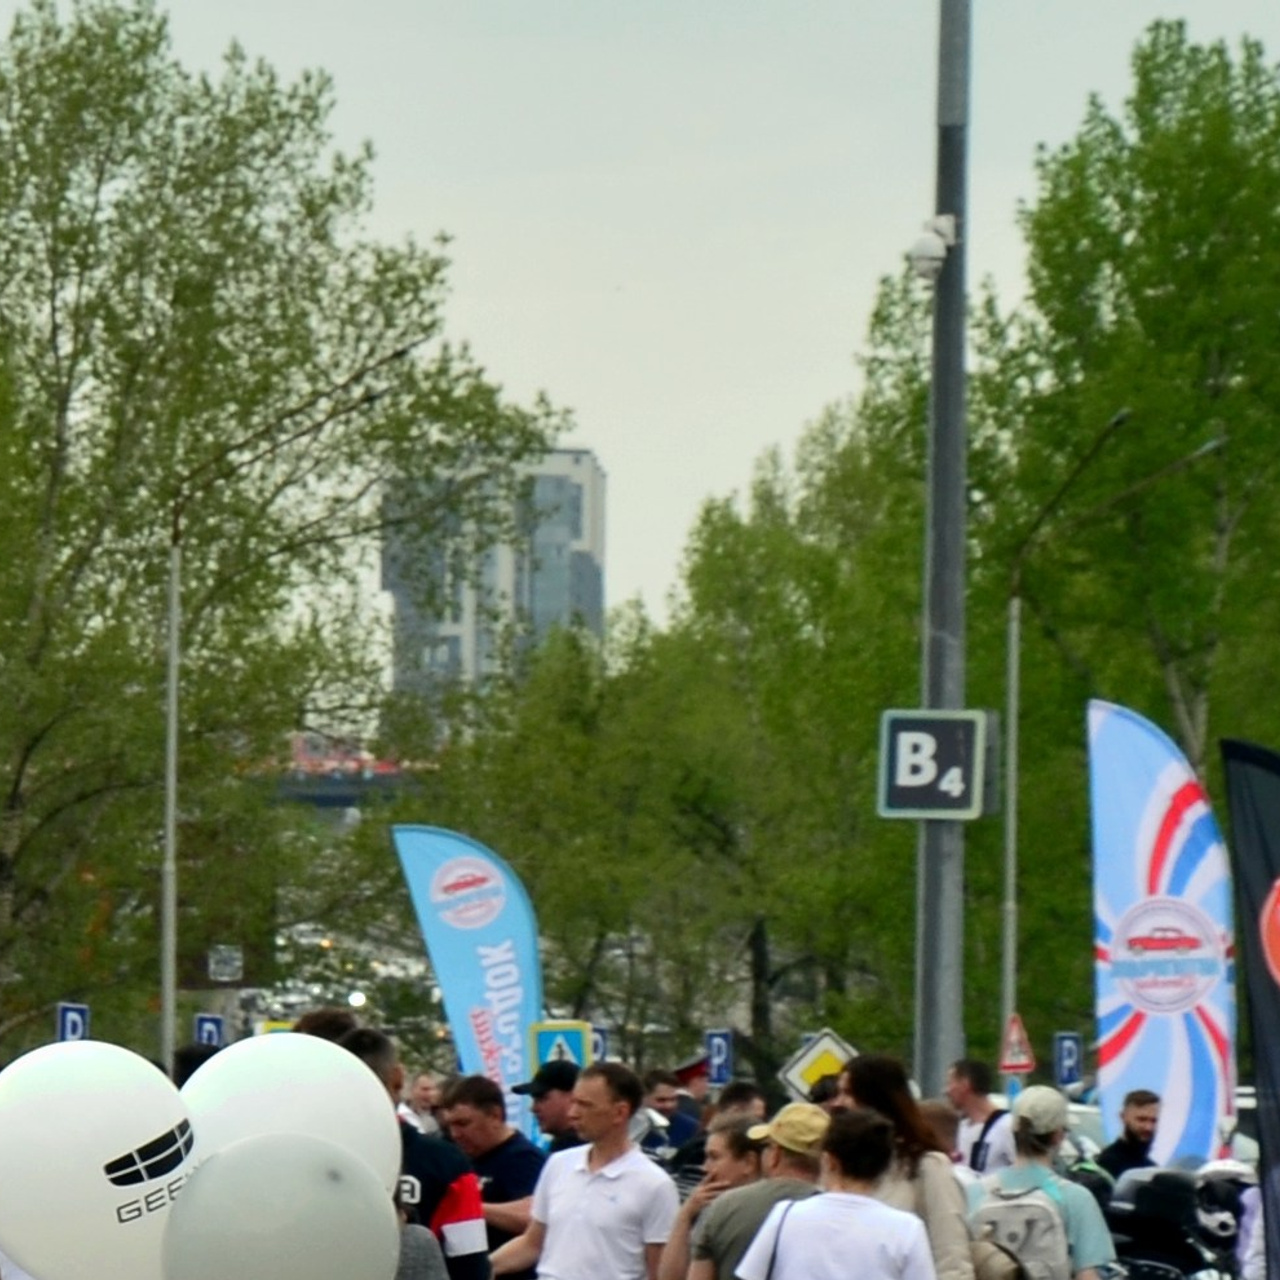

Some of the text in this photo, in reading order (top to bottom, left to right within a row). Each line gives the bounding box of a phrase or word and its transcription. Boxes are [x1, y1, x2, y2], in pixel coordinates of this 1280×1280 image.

[710, 1037, 728, 1079] P
[1061, 1039, 1078, 1078] P
[116, 1166, 200, 1224] GEE
